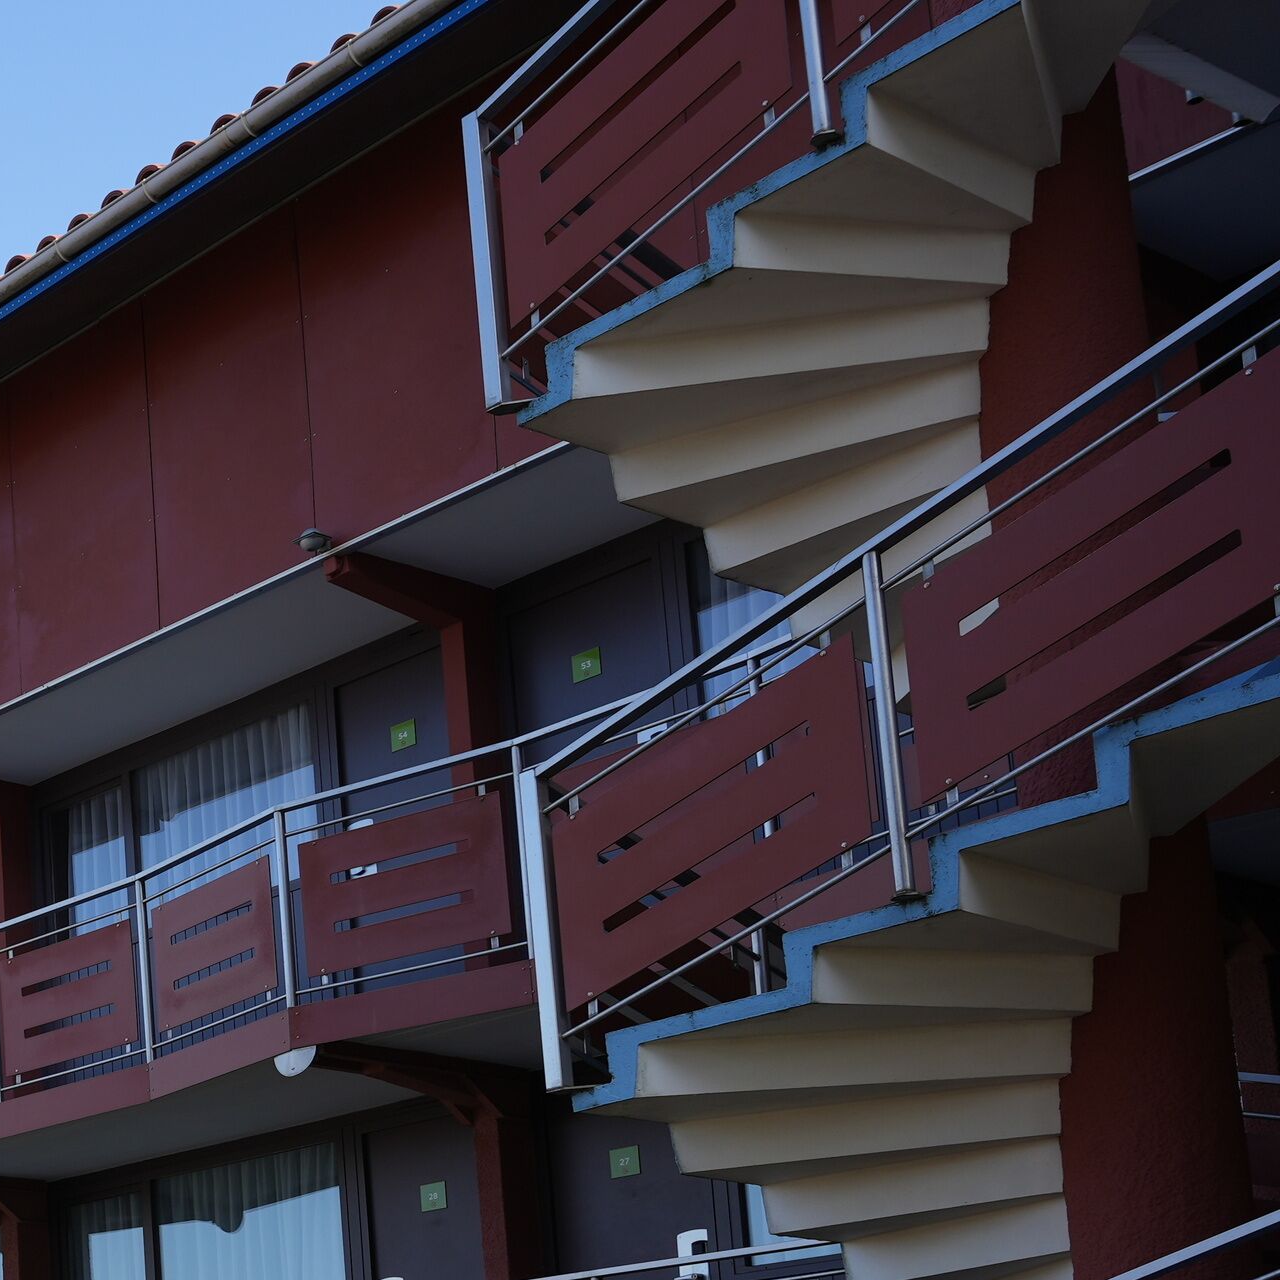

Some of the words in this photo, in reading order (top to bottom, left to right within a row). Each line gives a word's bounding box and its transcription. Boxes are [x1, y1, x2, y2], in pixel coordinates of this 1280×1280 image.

[580, 660, 592, 670] 53
[398, 731, 408, 740] 54
[619, 1158, 630, 1166] 27
[428, 1192, 438, 1201] 28
